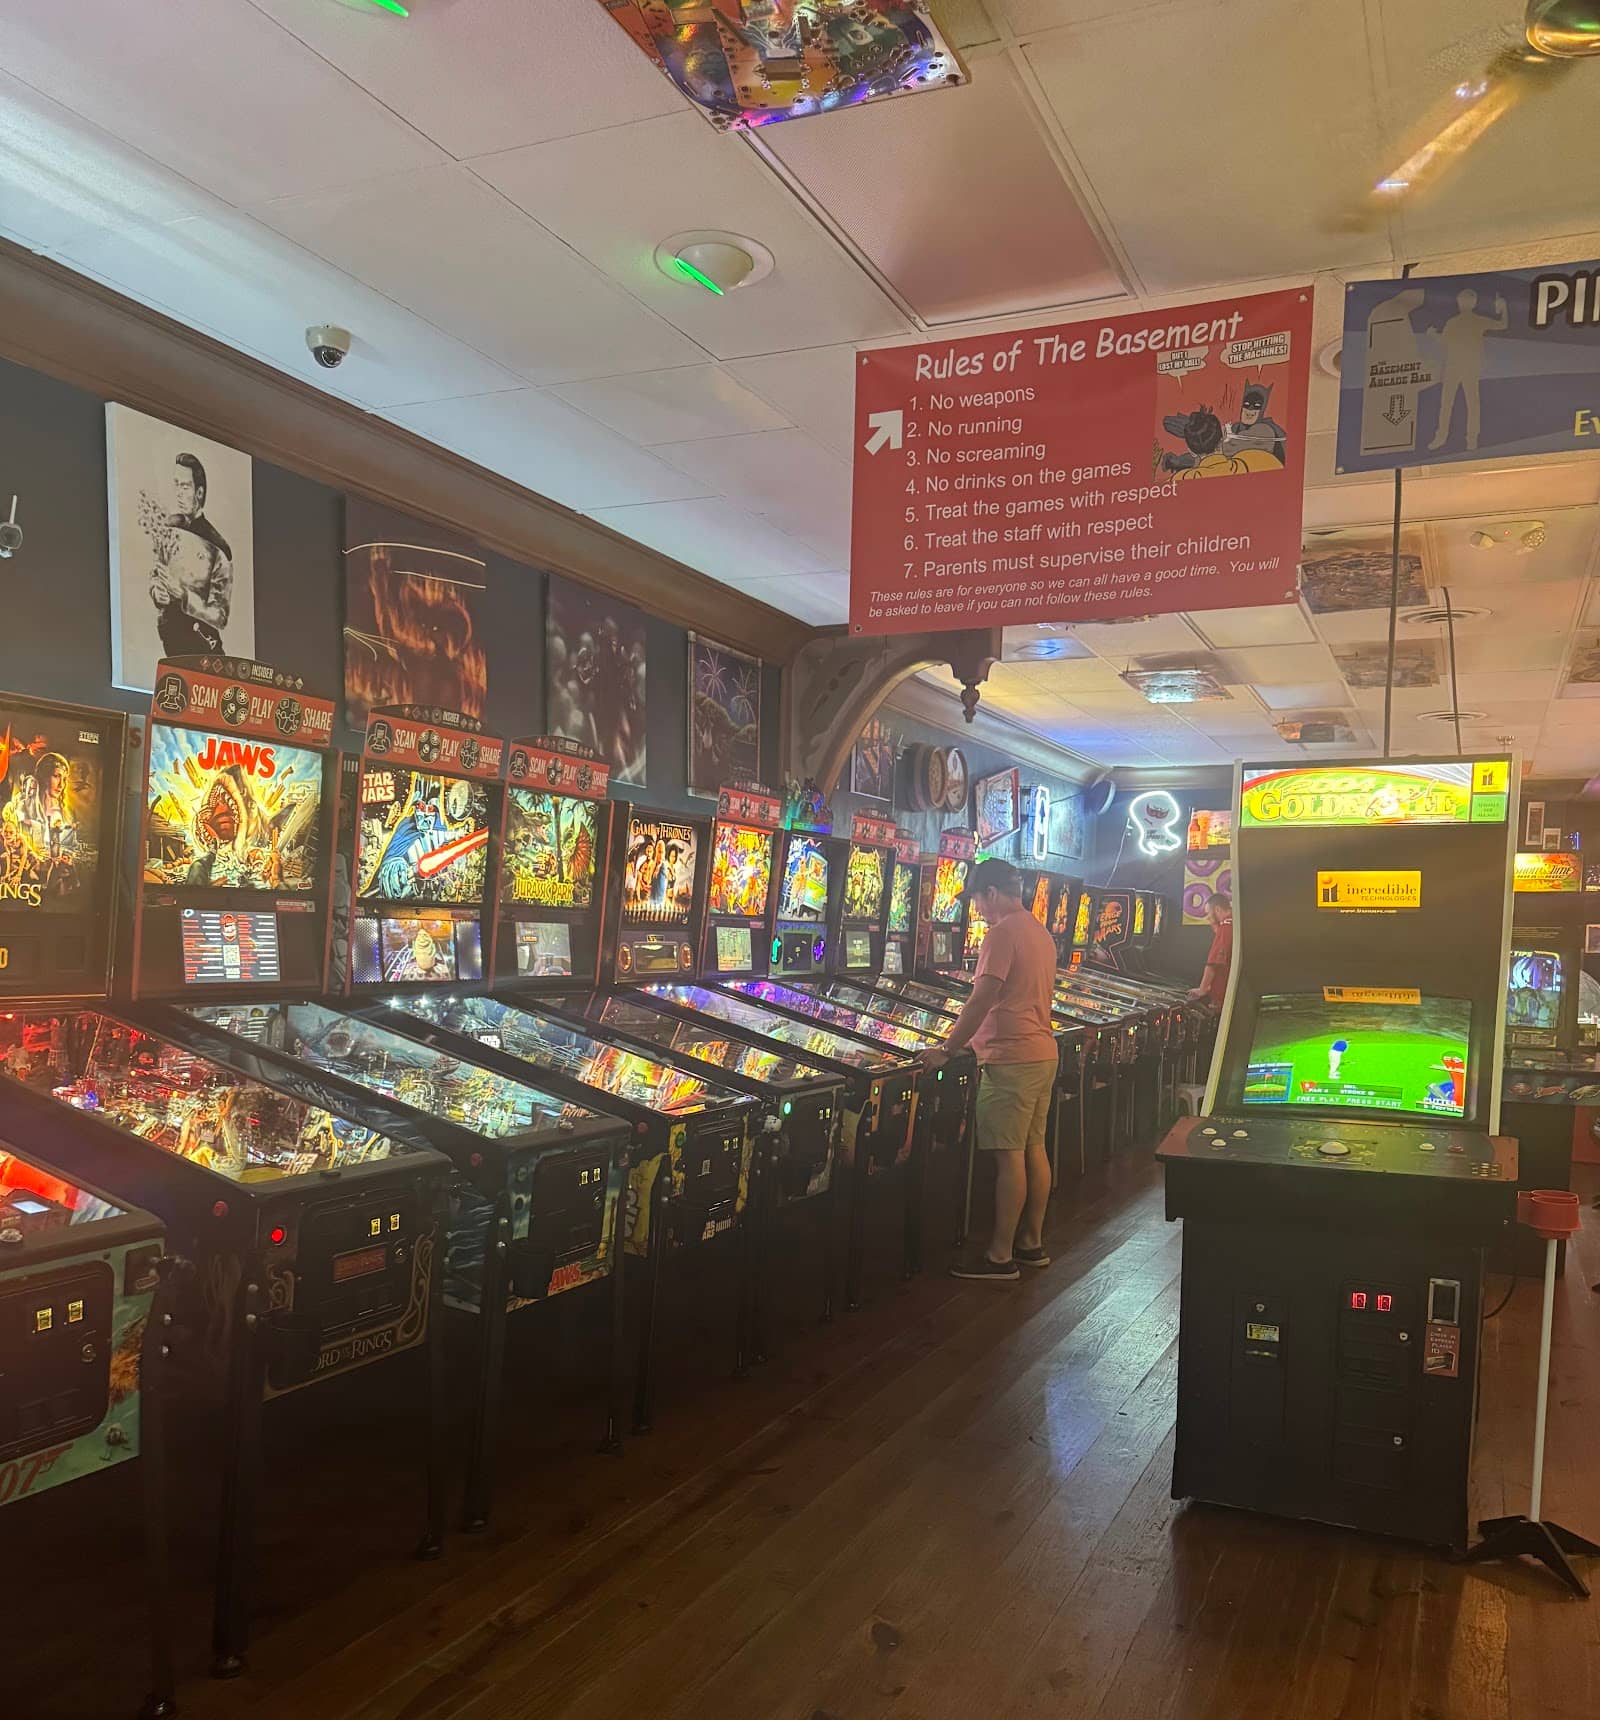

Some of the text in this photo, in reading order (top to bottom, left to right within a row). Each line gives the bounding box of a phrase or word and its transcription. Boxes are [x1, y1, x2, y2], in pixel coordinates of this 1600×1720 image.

[1535, 278, 1600, 326] PI
[915, 310, 1244, 382] Rules of The Basement
[1229, 345, 1288, 364] THE MACHINES!
[1232, 334, 1285, 353] STOP HITTING
[1174, 359, 1184, 370] MY
[1370, 362, 1421, 376] BASEMENT
[1369, 372, 1432, 388] ARCADE BAR
[909, 387, 1036, 411] 1. No weapons
[906, 416, 1023, 439] 2. No running
[906, 441, 1046, 467] 3. No screaming
[905, 461, 1132, 495] 4. No drinks on the games
[904, 480, 1179, 523] 5. Treat the games with respect
[903, 512, 1154, 551] 6. Treat the staff with respect
[903, 535, 1251, 579] 7. Parents must supervise their children
[870, 556, 1280, 603] These rules are for everyone so we can all have a good time. You will
[868, 586, 1153, 618] be asked to leave if you can not follow these rules.
[251, 664, 274, 680] INSIDER
[191, 685, 333, 731] SCAN PLAY SHARE
[198, 737, 276, 778] JAWS
[393, 729, 502, 765] SCAN PLAY SHARE
[529, 757, 546, 774] SCAN
[563, 764, 577, 780] PLAY
[659, 822, 693, 840] THRONES
[513, 878, 574, 901] JURASSIC PARK
[1347, 884, 1416, 894] incredible
[549, 1262, 580, 1291] AWS
[351, 1330, 392, 1359] RINGS
